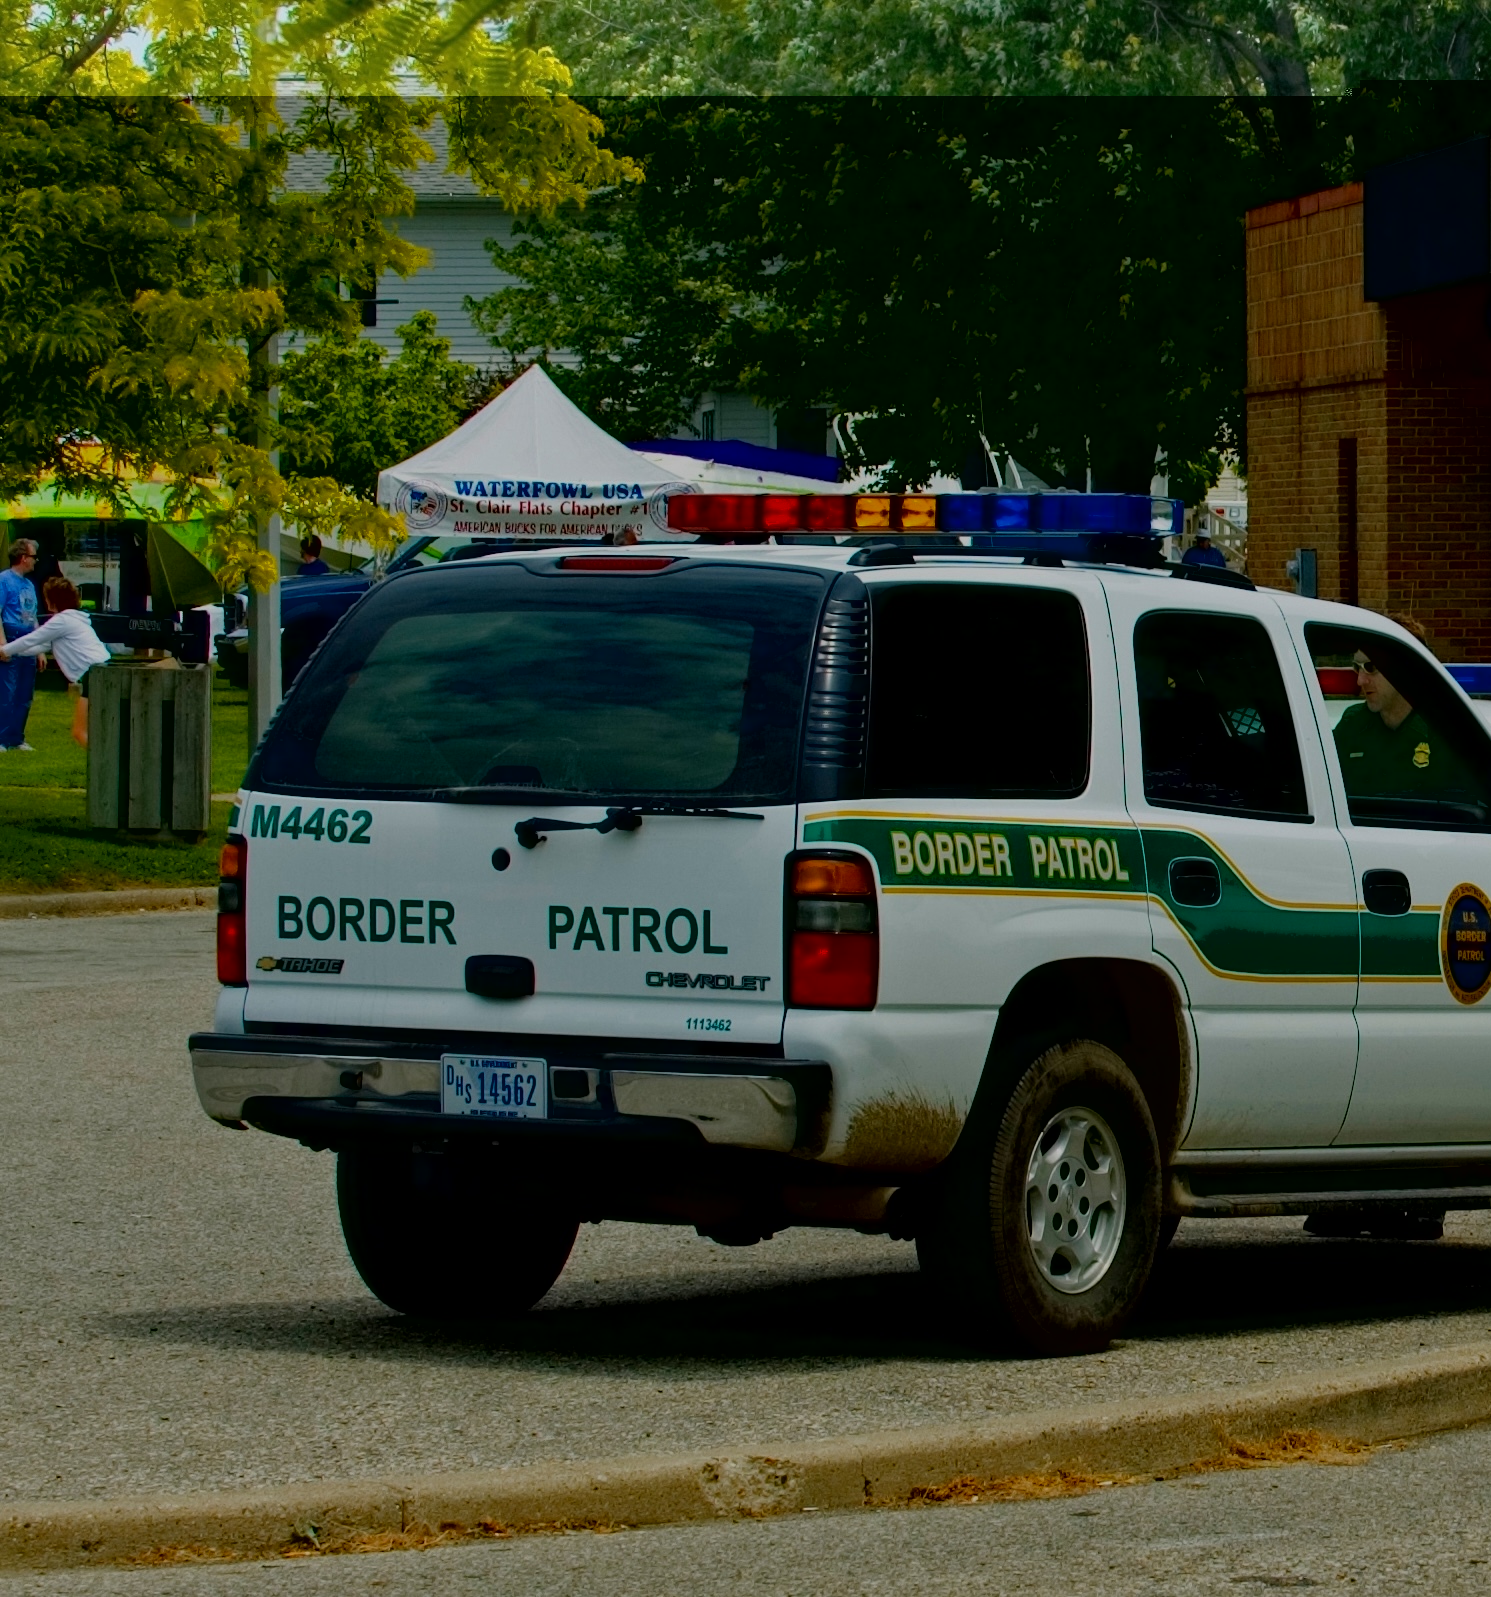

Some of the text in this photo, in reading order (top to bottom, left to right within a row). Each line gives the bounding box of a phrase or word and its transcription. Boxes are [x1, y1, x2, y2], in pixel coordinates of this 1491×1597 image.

[455, 481, 644, 499] WATERFOWL USA
[450, 499, 648, 519] St. Clair Flats Chapter #1
[454, 521, 501, 534] AMERICAN
[540, 523, 557, 535] FOR
[560, 523, 608, 536] AMERICAN
[251, 804, 373, 844] M4462
[890, 830, 1130, 882] BORDER PATROL
[278, 895, 728, 955] BORDER PATROL
[1462, 911, 1479, 923] U.S.
[1455, 930, 1487, 943] BORDER
[1457, 950, 1486, 962] PATROL
[281, 958, 341, 973] TAHOE
[646, 971, 771, 992] CHEVROLET
[686, 1018, 732, 1031] 1113462
[478, 1072, 537, 1107] 14562
